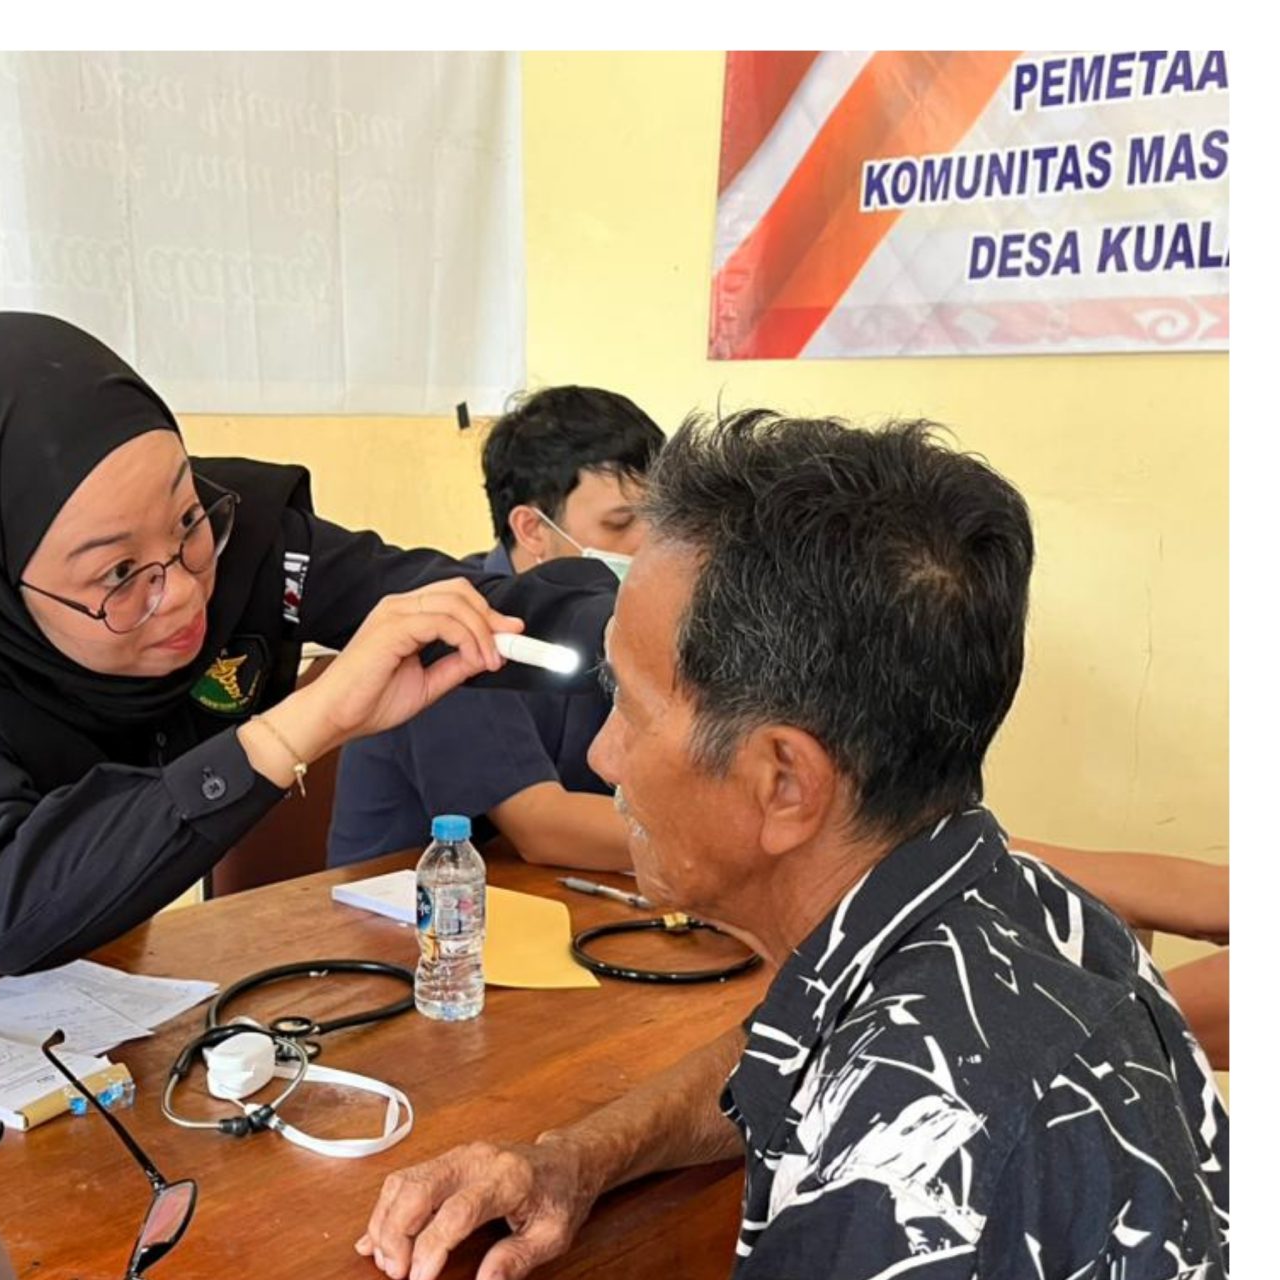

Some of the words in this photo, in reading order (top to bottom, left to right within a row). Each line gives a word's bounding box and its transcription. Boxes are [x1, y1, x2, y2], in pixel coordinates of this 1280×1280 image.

[1013, 51, 1228, 111] PEMETAA
[863, 141, 1112, 208] KOMUNITAS
[1126, 129, 1229, 186] MAS
[968, 230, 1081, 280] DESA
[1097, 221, 1229, 274] KUAL
